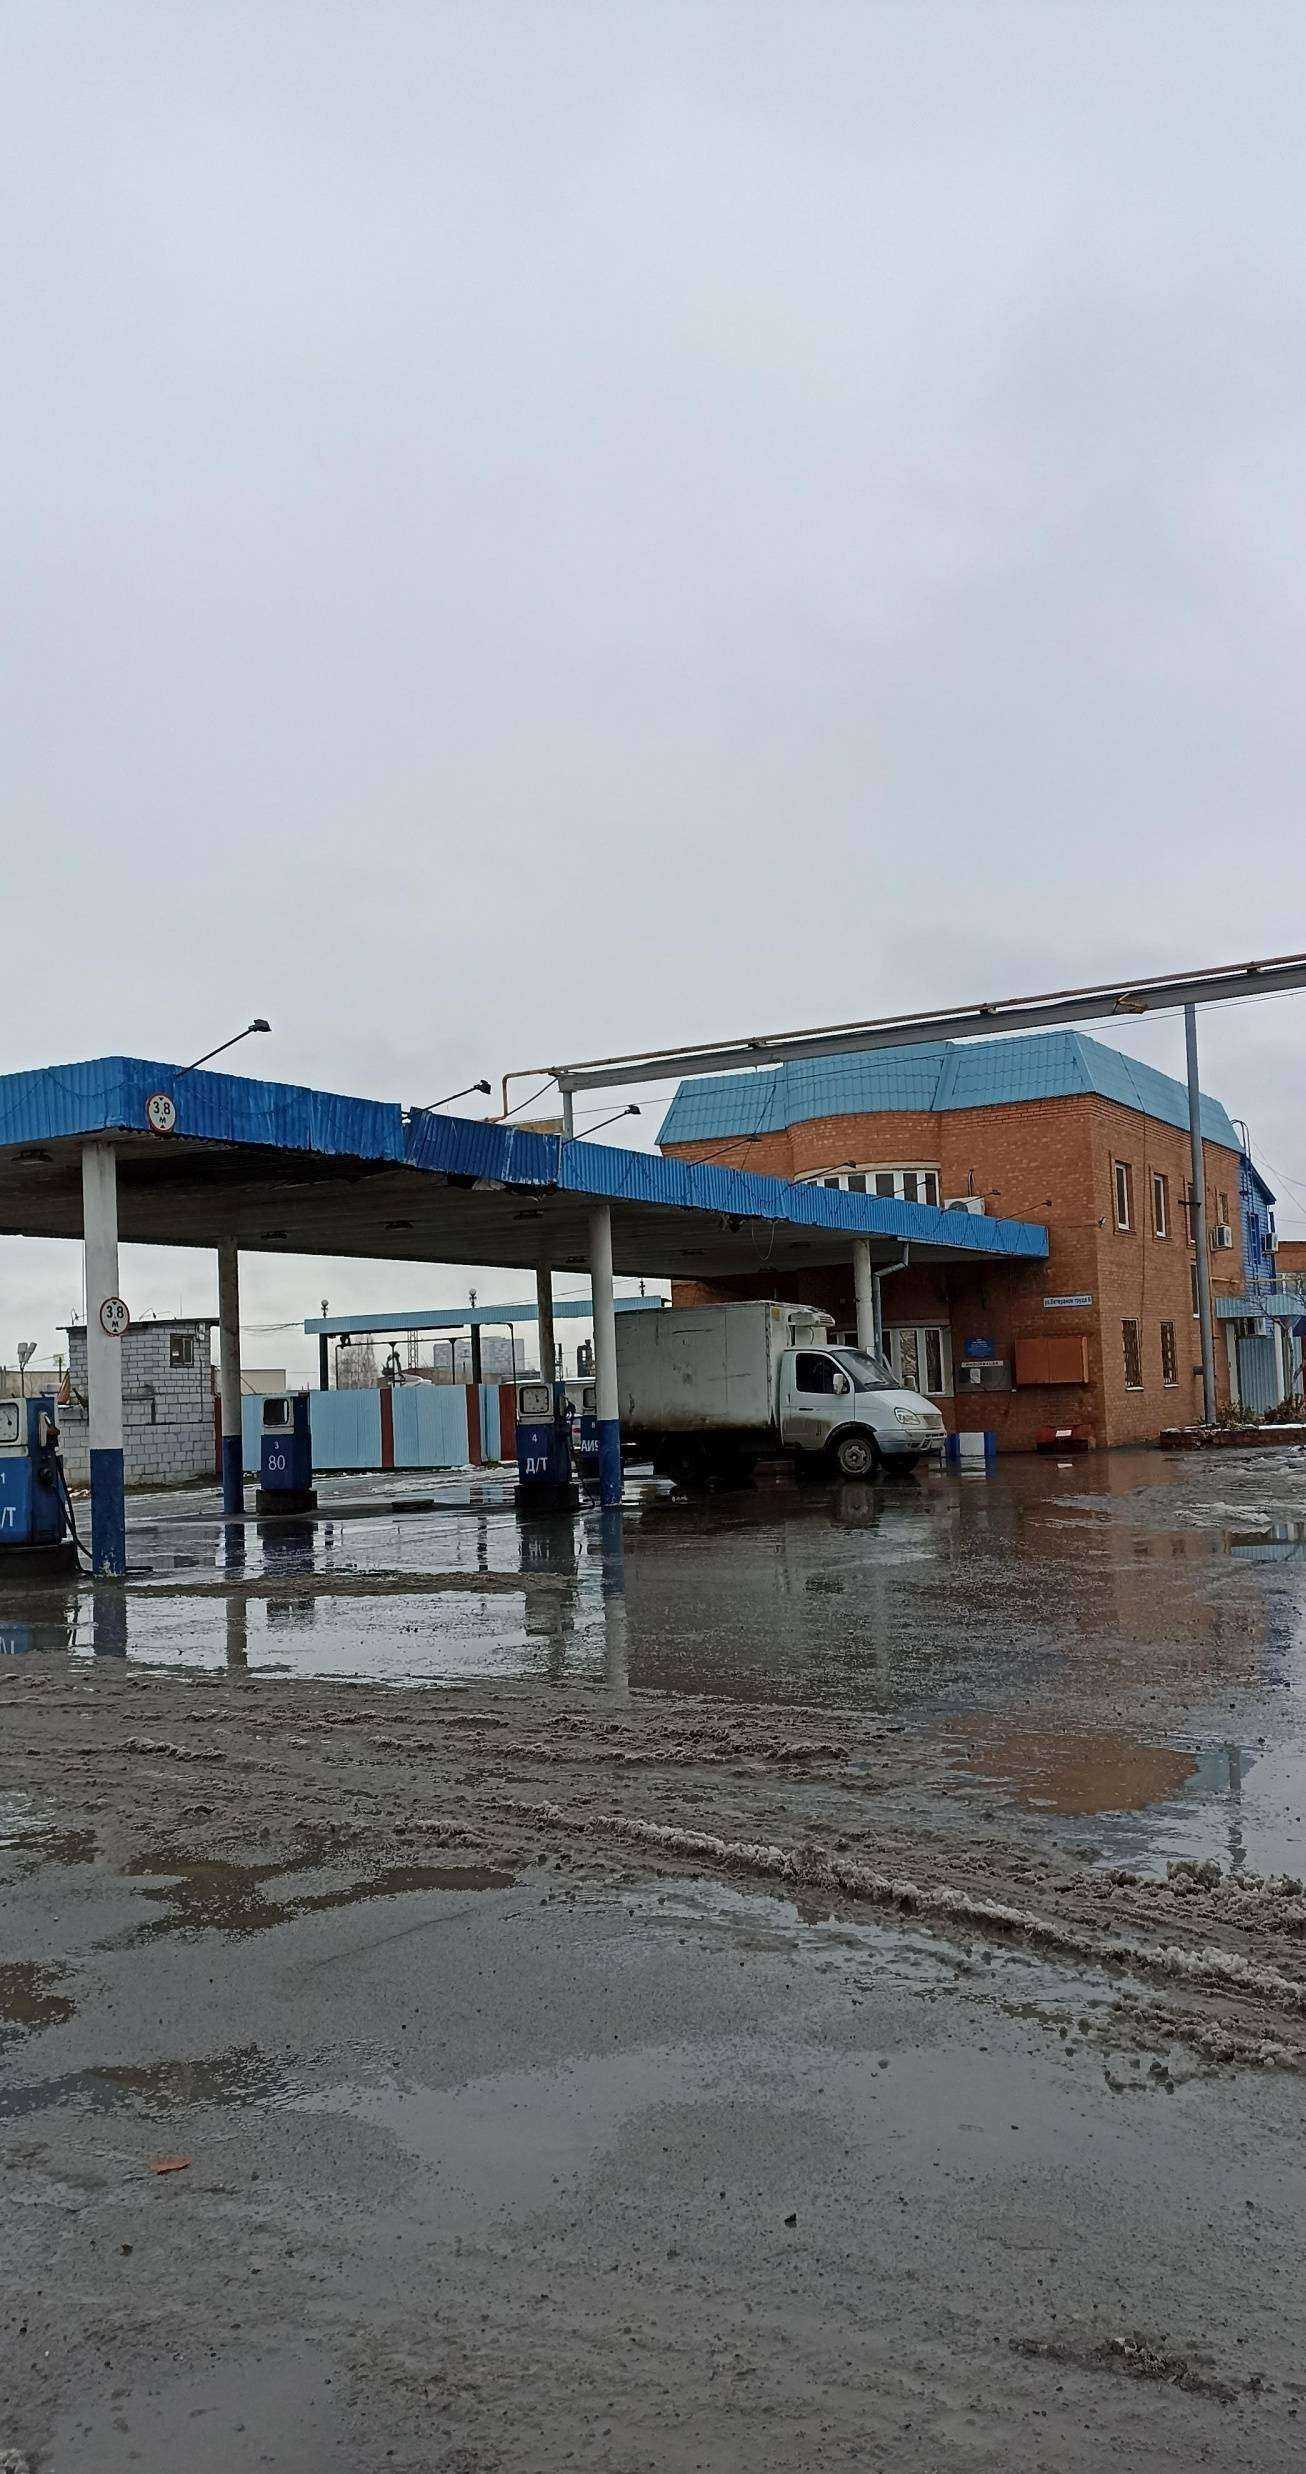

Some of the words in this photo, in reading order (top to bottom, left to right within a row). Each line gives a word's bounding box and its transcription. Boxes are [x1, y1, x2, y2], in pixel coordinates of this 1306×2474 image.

[531, 1433, 538, 1442] 4
[274, 1441, 280, 1450] 3
[268, 1454, 286, 1471] 80
[525, 1457, 548, 1475] Д/Т
[0, 1472, 6, 1485] 1
[0, 1506, 17, 1529] /Т
